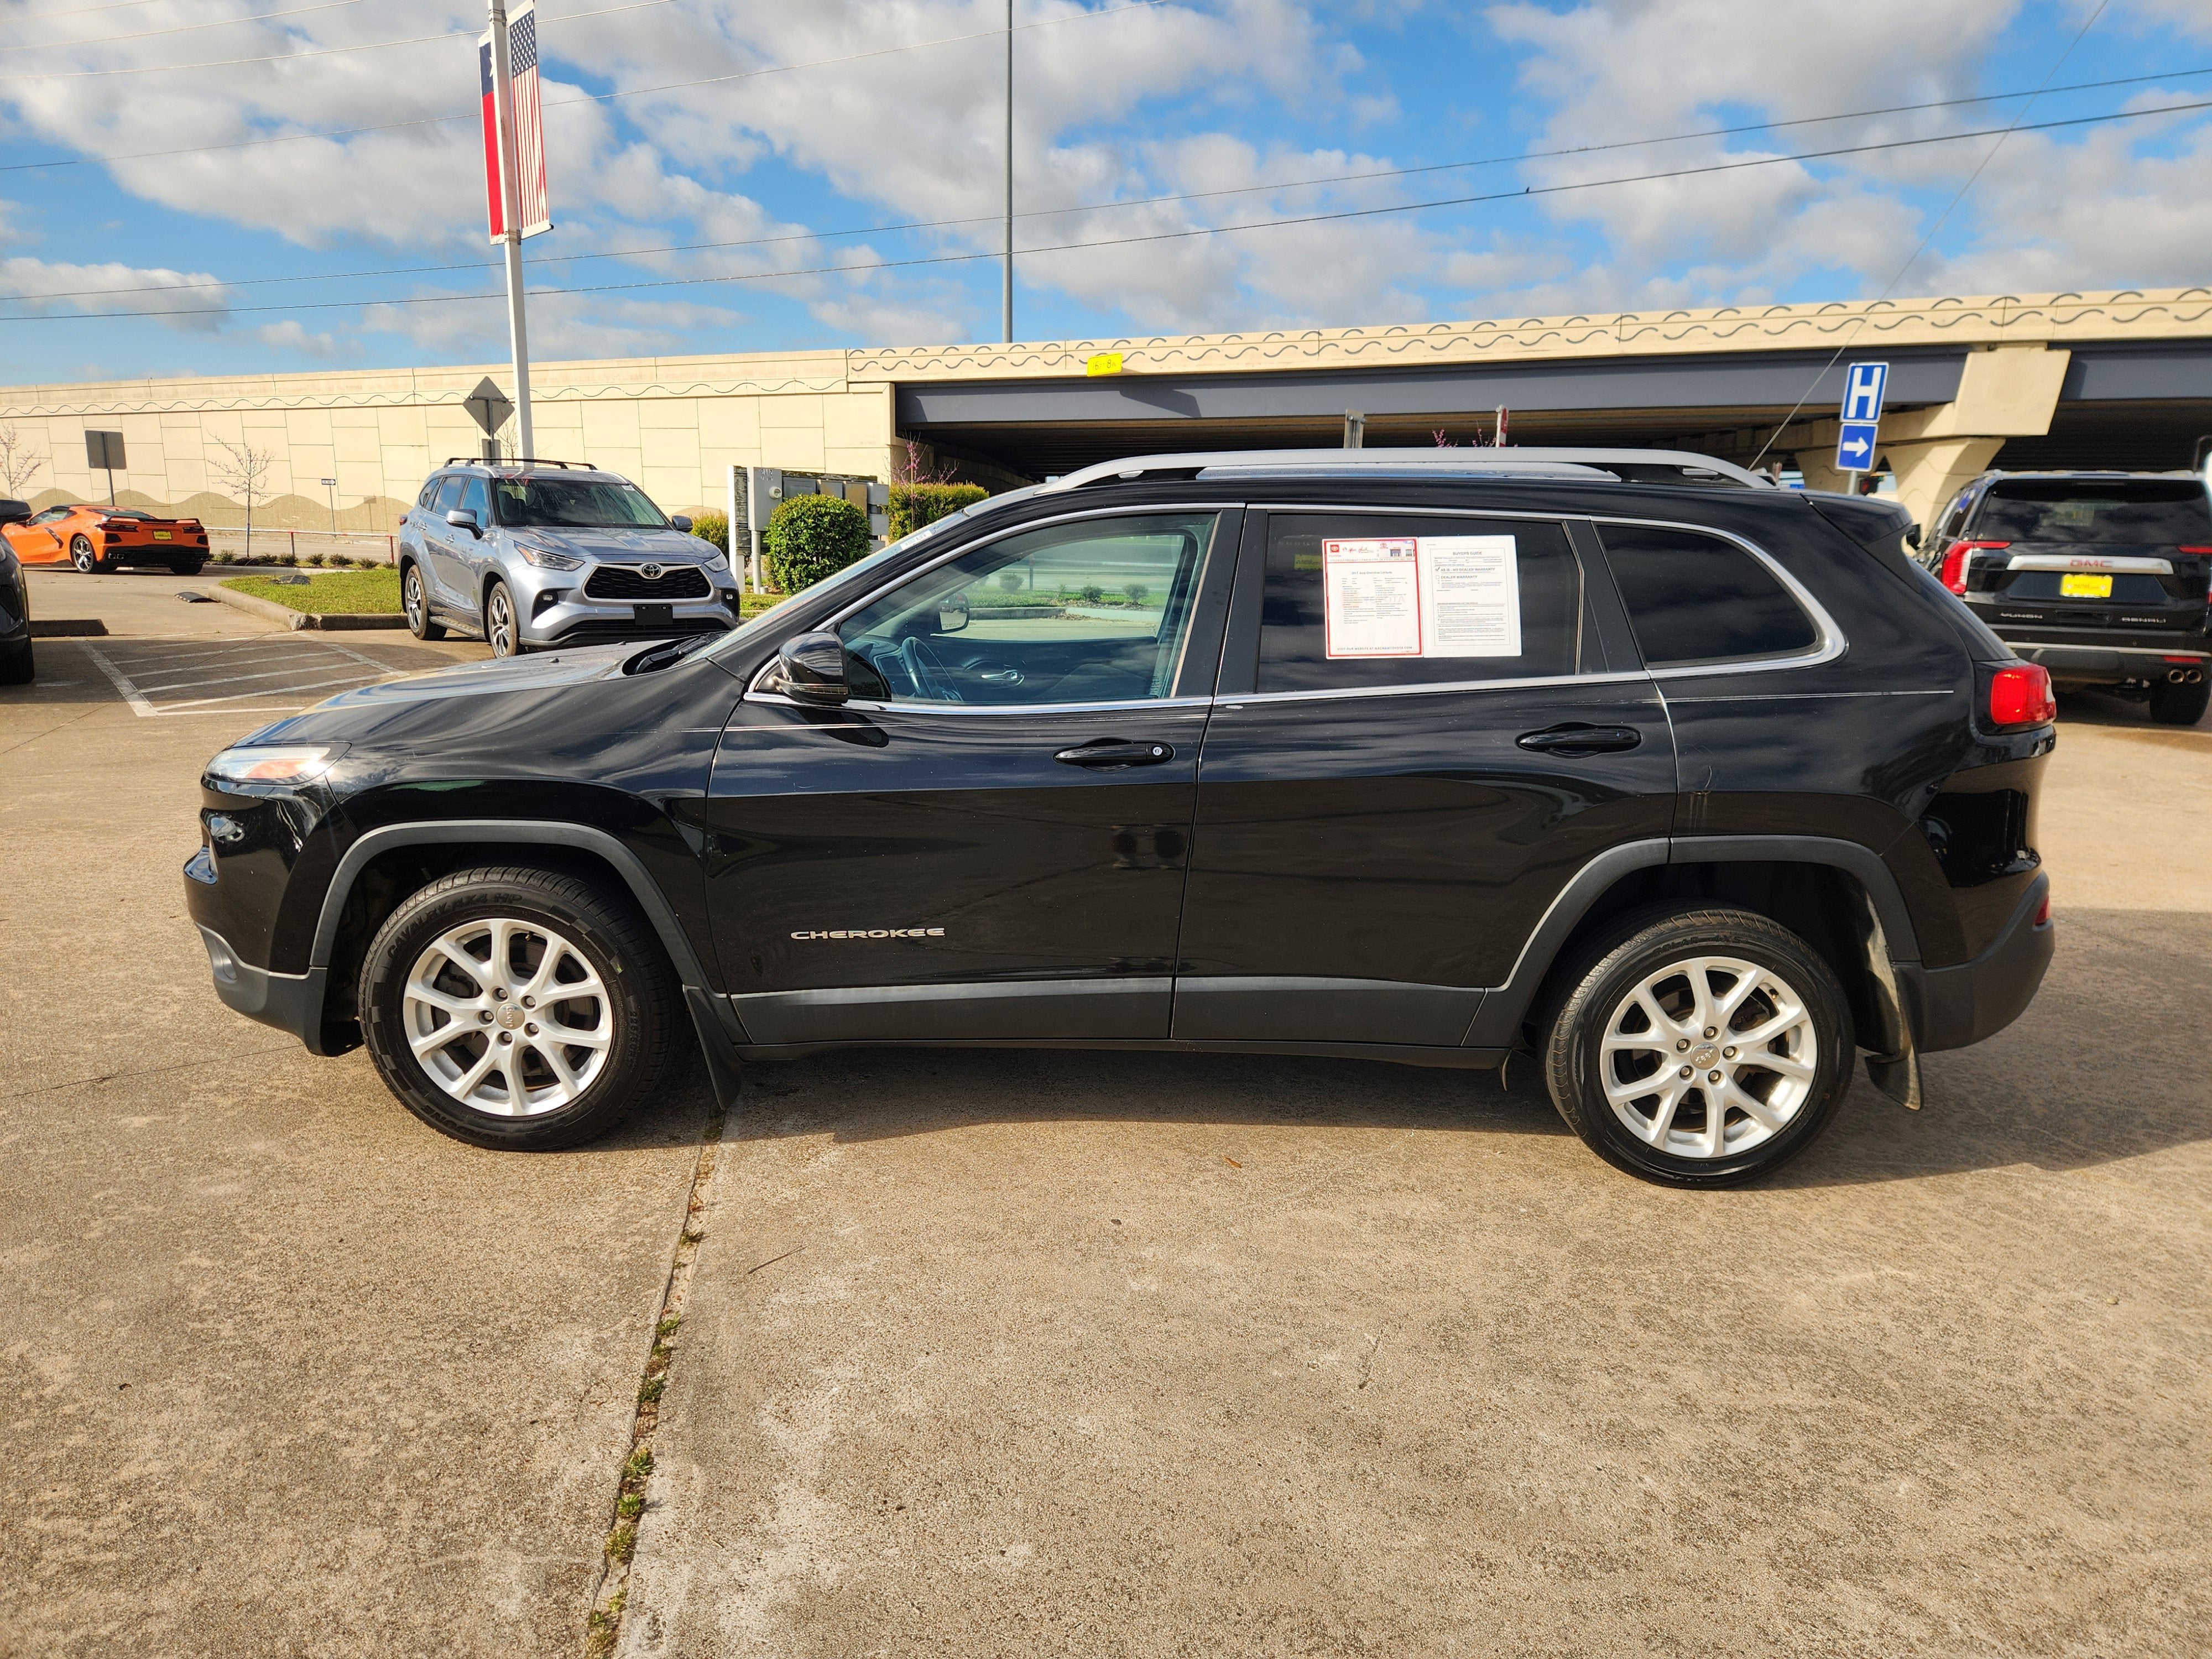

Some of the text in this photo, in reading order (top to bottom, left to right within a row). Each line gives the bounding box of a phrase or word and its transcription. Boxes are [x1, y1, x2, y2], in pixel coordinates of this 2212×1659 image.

[1846, 367, 1882, 419] H
[2069, 560, 2112, 568] GMC
[493, 893, 523, 904] HP
[790, 927, 946, 940] CHEROKEE
